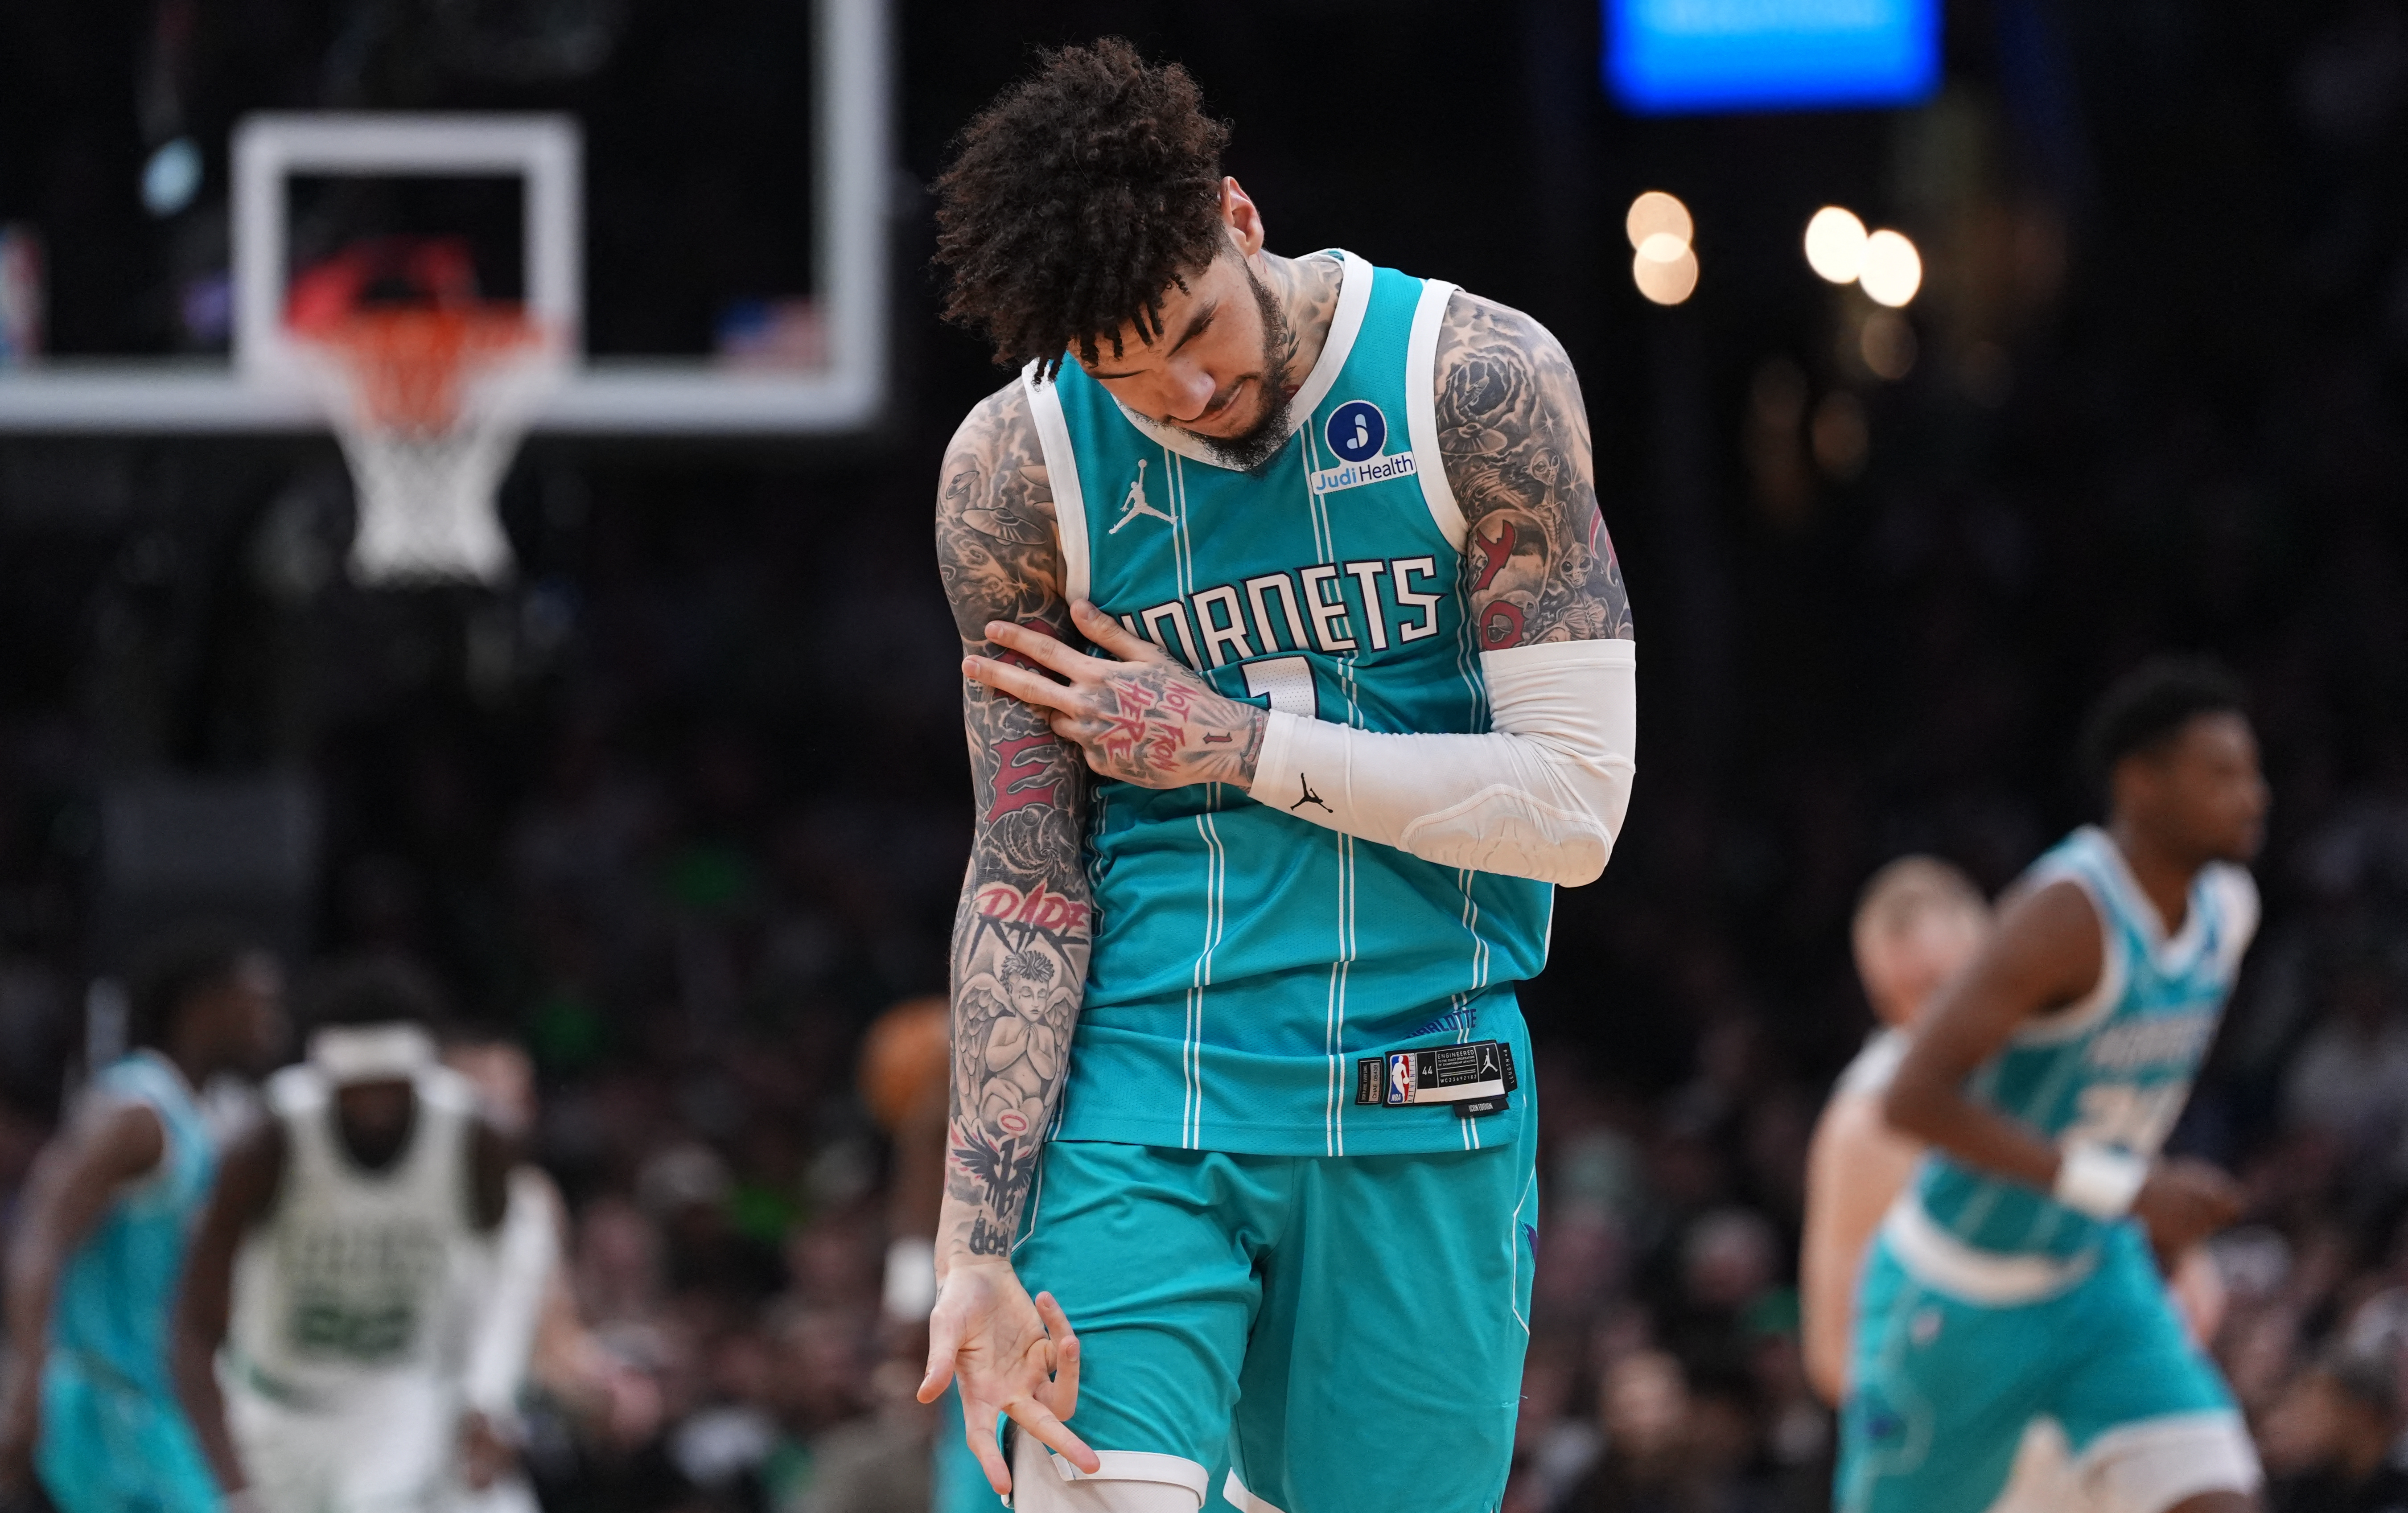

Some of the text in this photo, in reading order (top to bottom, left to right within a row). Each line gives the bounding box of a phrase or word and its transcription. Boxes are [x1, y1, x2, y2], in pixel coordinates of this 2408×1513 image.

[1316, 455, 1413, 490] Judi Health
[1118, 555, 1448, 671] ORNETS
[1159, 680, 1203, 723] NOT
[1097, 680, 1155, 764] HERE
[1148, 720, 1185, 773] FROM
[1437, 1049, 1474, 1060] ENGINEERED
[1422, 1065, 1433, 1075] 44
[1505, 1058, 1514, 1084] LENGTH
[1391, 1094, 1401, 1102] NBA
[1478, 1102, 1493, 1111] EDITION
